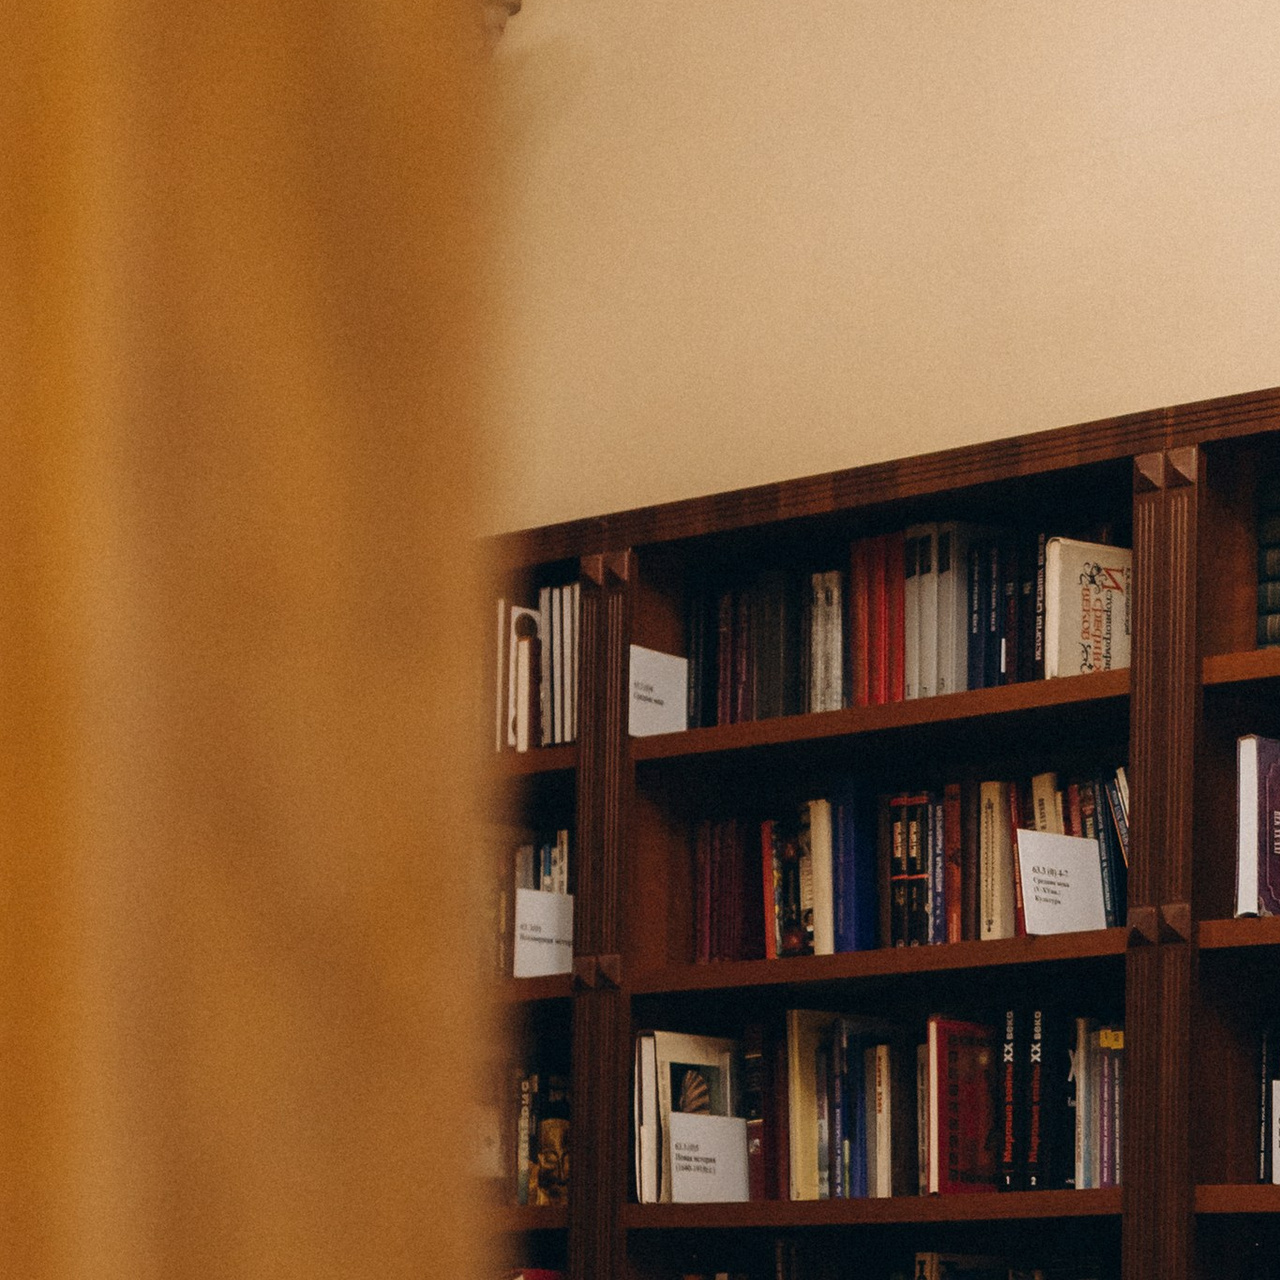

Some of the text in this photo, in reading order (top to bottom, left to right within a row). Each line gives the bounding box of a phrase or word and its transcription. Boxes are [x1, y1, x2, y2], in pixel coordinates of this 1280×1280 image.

[1003, 1010, 1015, 1163] Мировые войны XX века
[1028, 1010, 1042, 1163] Мировые войны XX века
